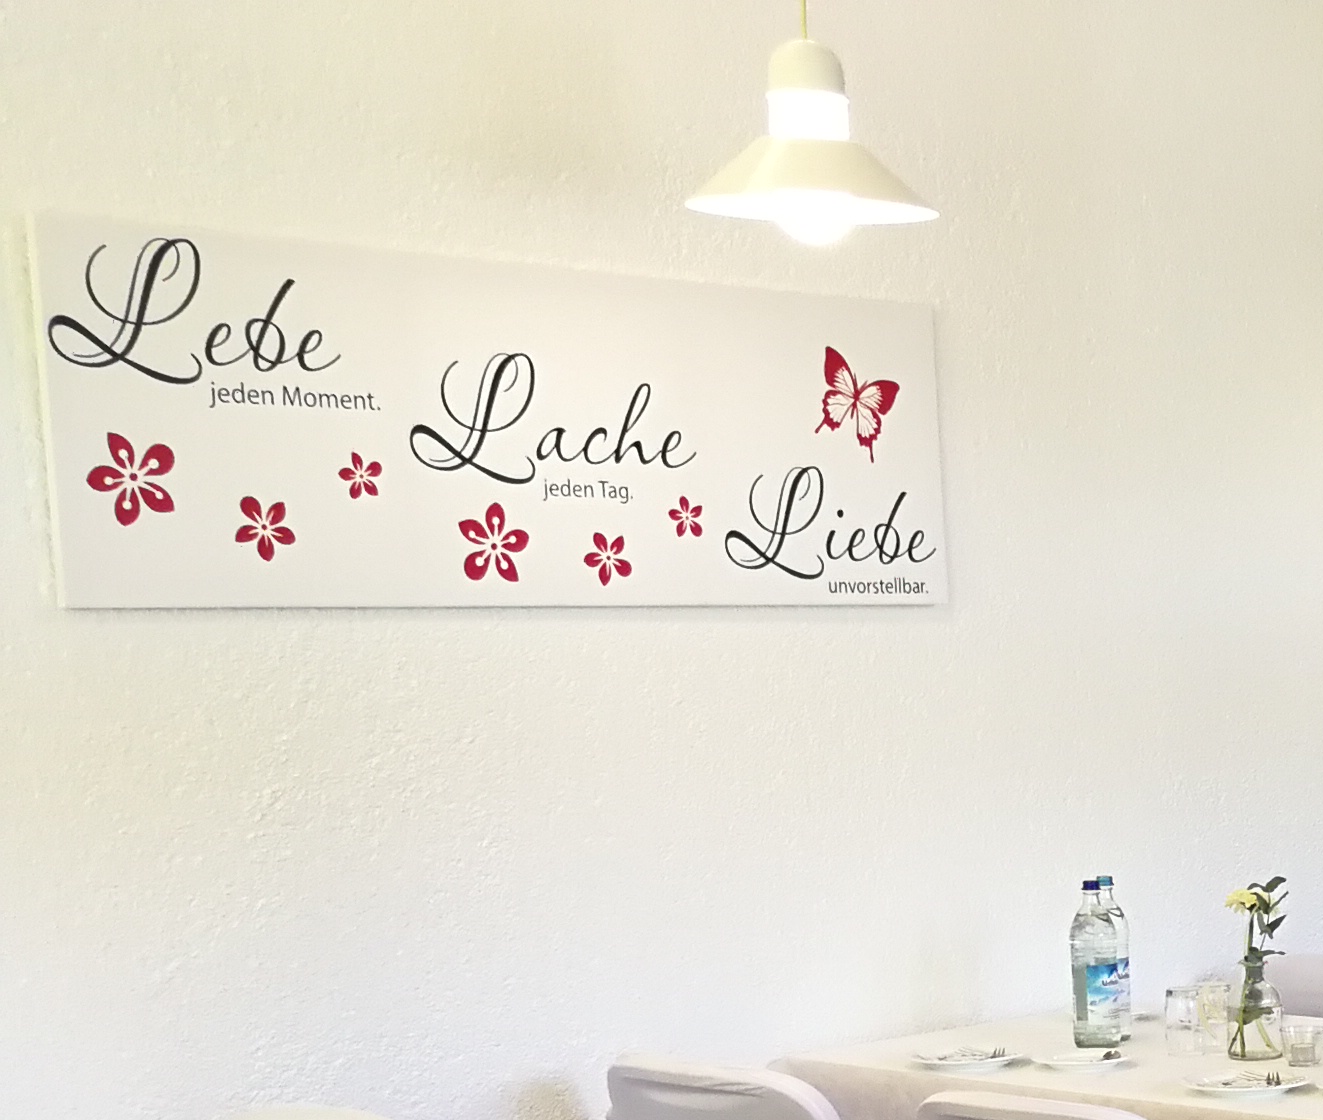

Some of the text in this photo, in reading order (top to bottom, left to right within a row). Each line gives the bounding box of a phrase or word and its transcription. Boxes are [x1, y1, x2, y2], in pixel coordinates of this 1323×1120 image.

[47, 237, 342, 385] Lebe
[208, 381, 382, 411] jeden Moment.
[409, 352, 697, 485] Lache
[542, 478, 634, 504] jeden Tag.
[724, 466, 937, 580] Liebe
[828, 577, 930, 595] unvorstellbar.
